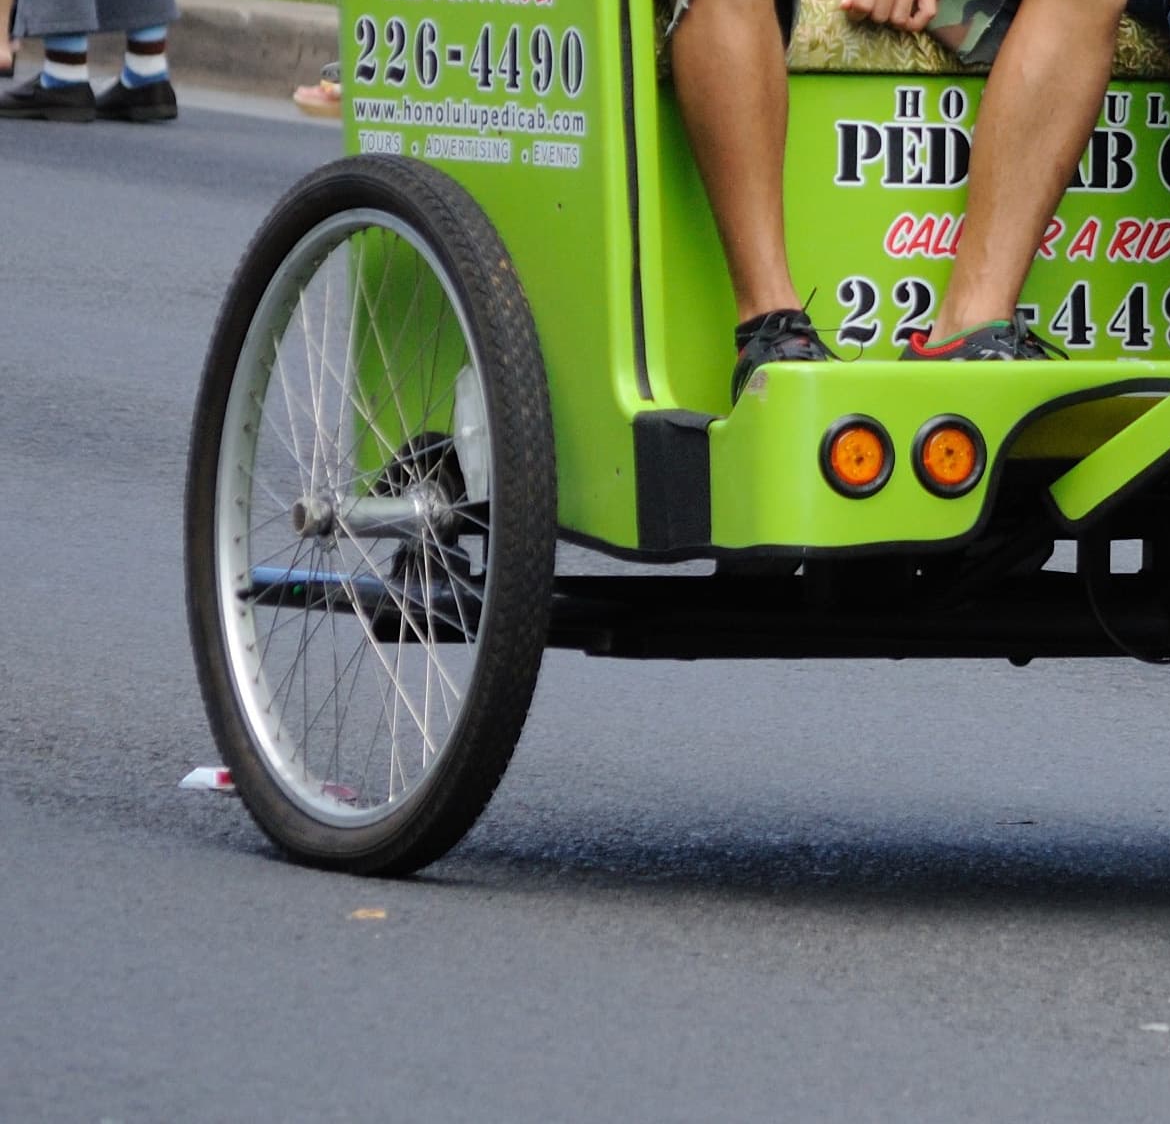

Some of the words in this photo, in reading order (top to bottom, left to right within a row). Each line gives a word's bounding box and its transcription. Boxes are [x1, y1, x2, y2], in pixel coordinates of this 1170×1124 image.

[355, 18, 584, 96] 226-4490
[354, 98, 584, 133] www.honolulupedicab.com
[360, 132, 400, 152] TOURS
[425, 137, 509, 161] ADVERTISING
[533, 144, 579, 165] EVENTS
[1070, 220, 1098, 258] A
